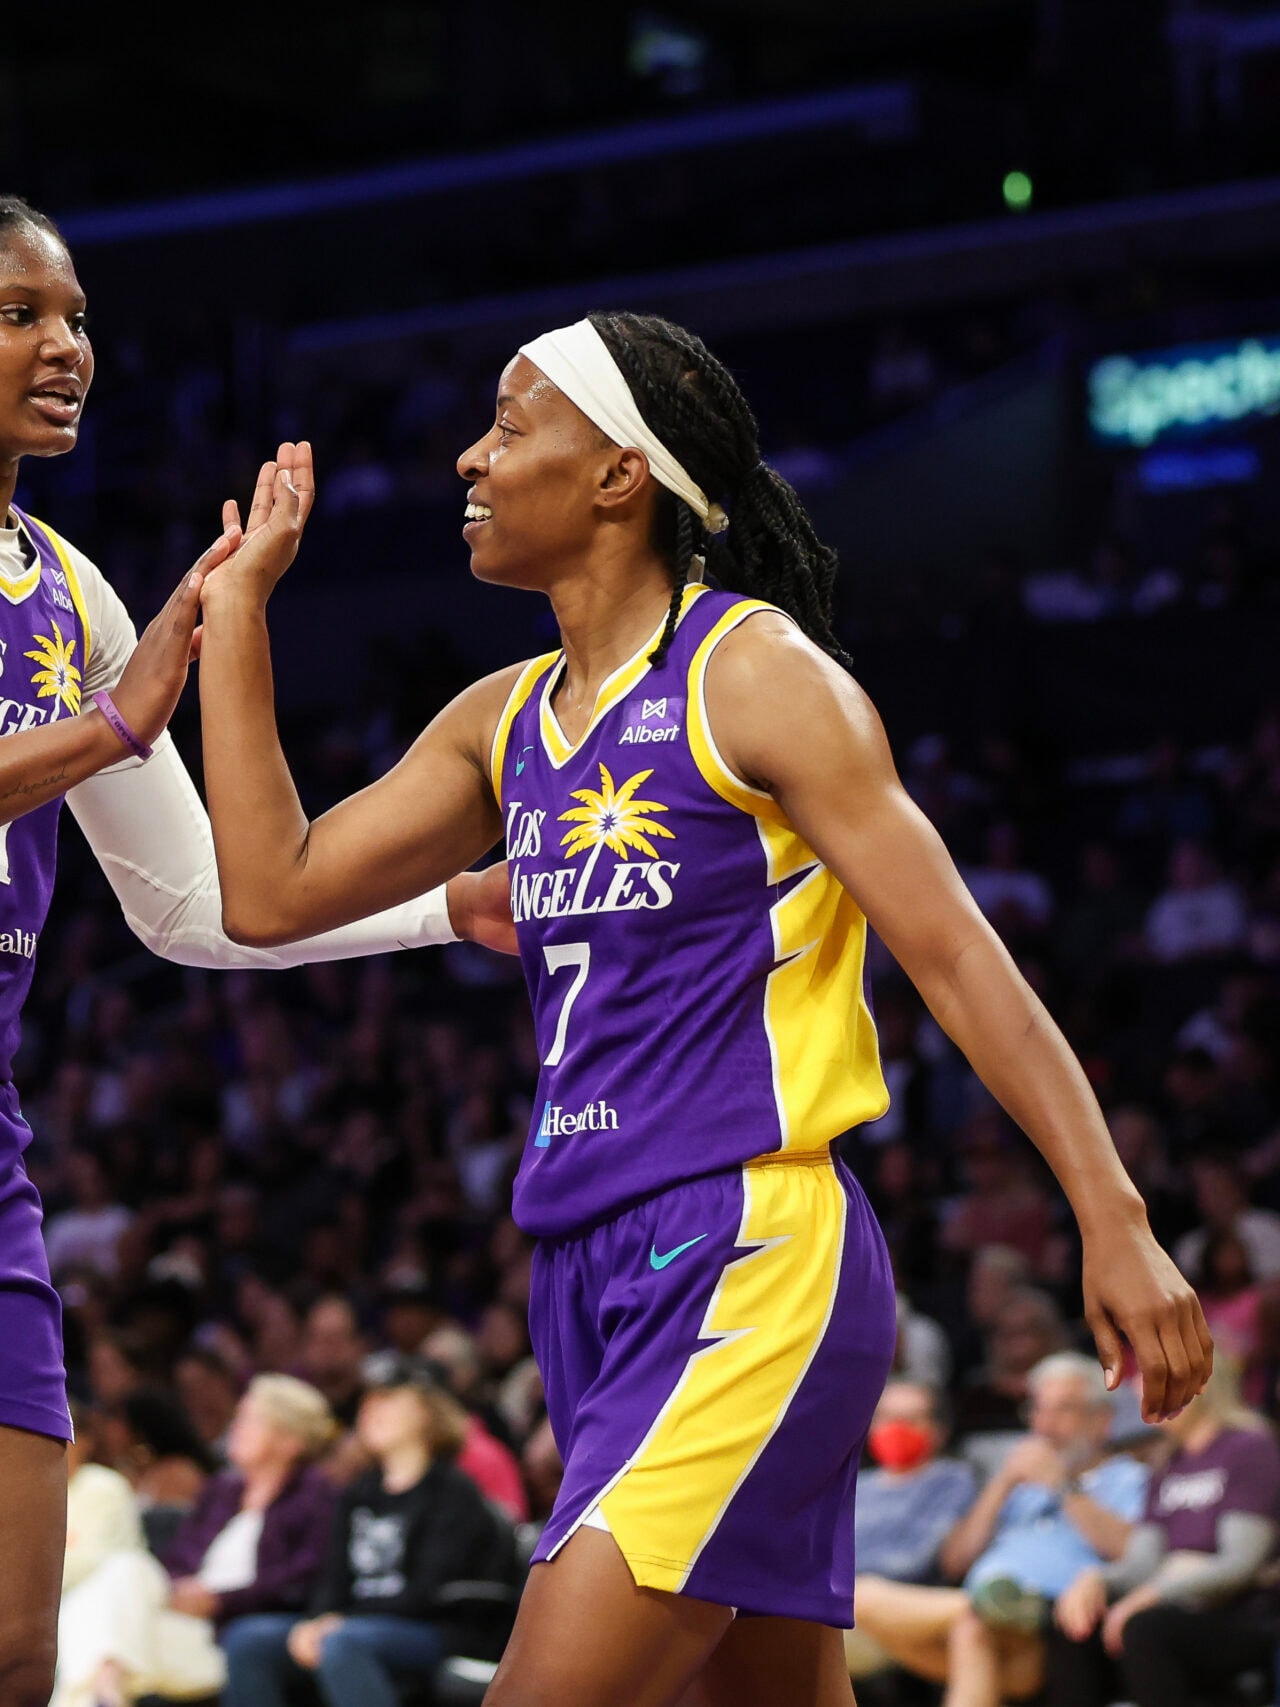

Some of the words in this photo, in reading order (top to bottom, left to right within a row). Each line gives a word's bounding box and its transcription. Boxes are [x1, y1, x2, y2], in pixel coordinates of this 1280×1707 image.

[52, 587, 74, 614] Albe
[619, 723, 680, 745] Albert
[506, 801, 547, 861] LOS
[510, 850, 681, 923] ANGELES
[542, 942, 591, 1066] 7
